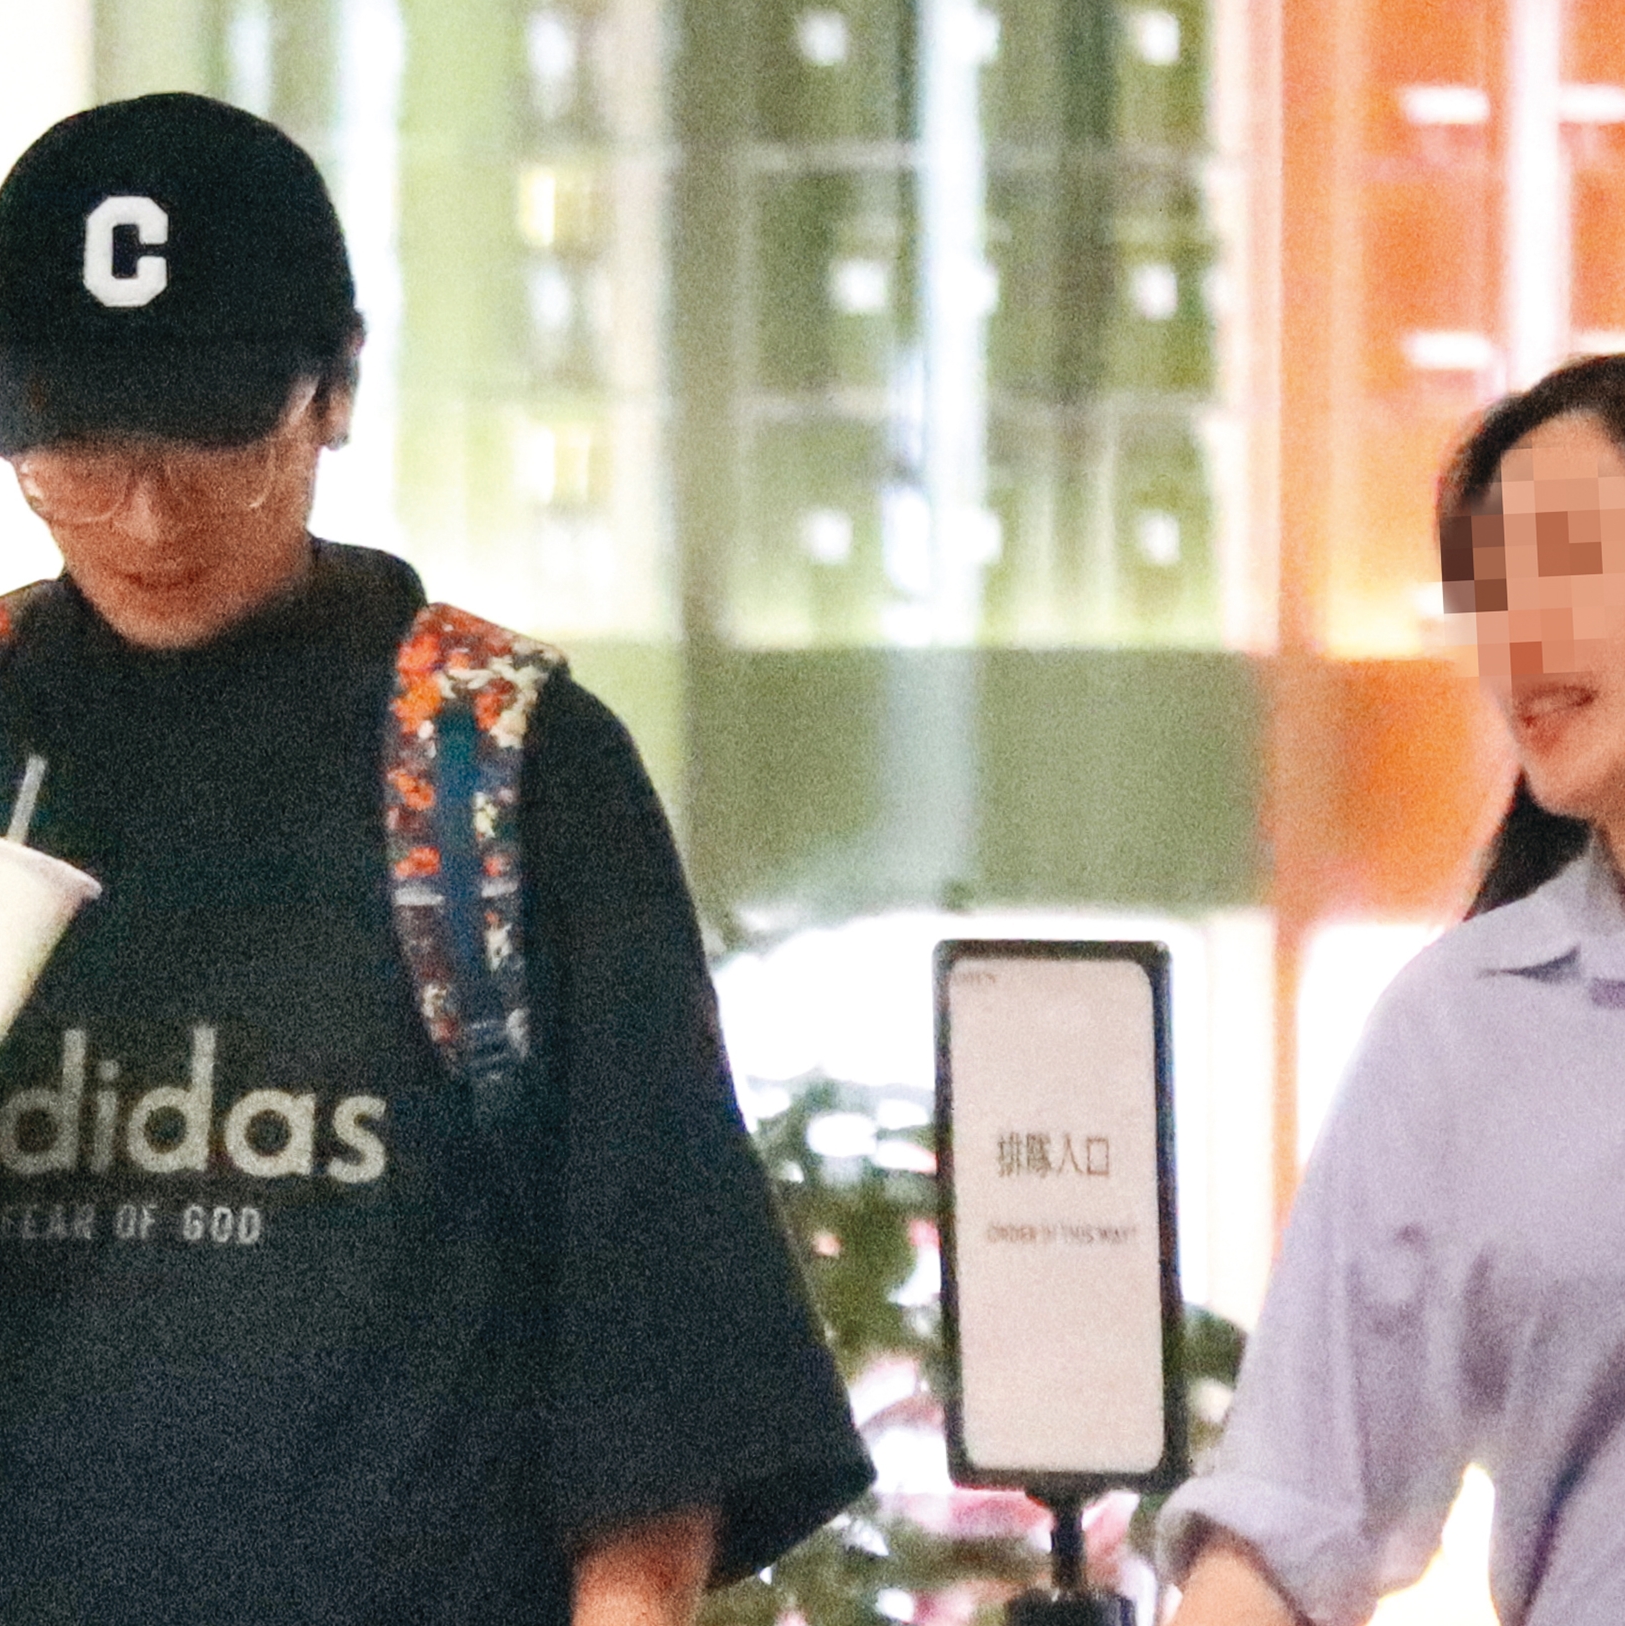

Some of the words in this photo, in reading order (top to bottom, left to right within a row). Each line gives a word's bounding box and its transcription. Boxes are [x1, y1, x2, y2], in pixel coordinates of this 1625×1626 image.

[83, 195, 169, 308] C
[996, 1131, 1111, 1179] 排隊入口
[115, 1203, 158, 1241] OF
[181, 1203, 263, 1245] GOD
